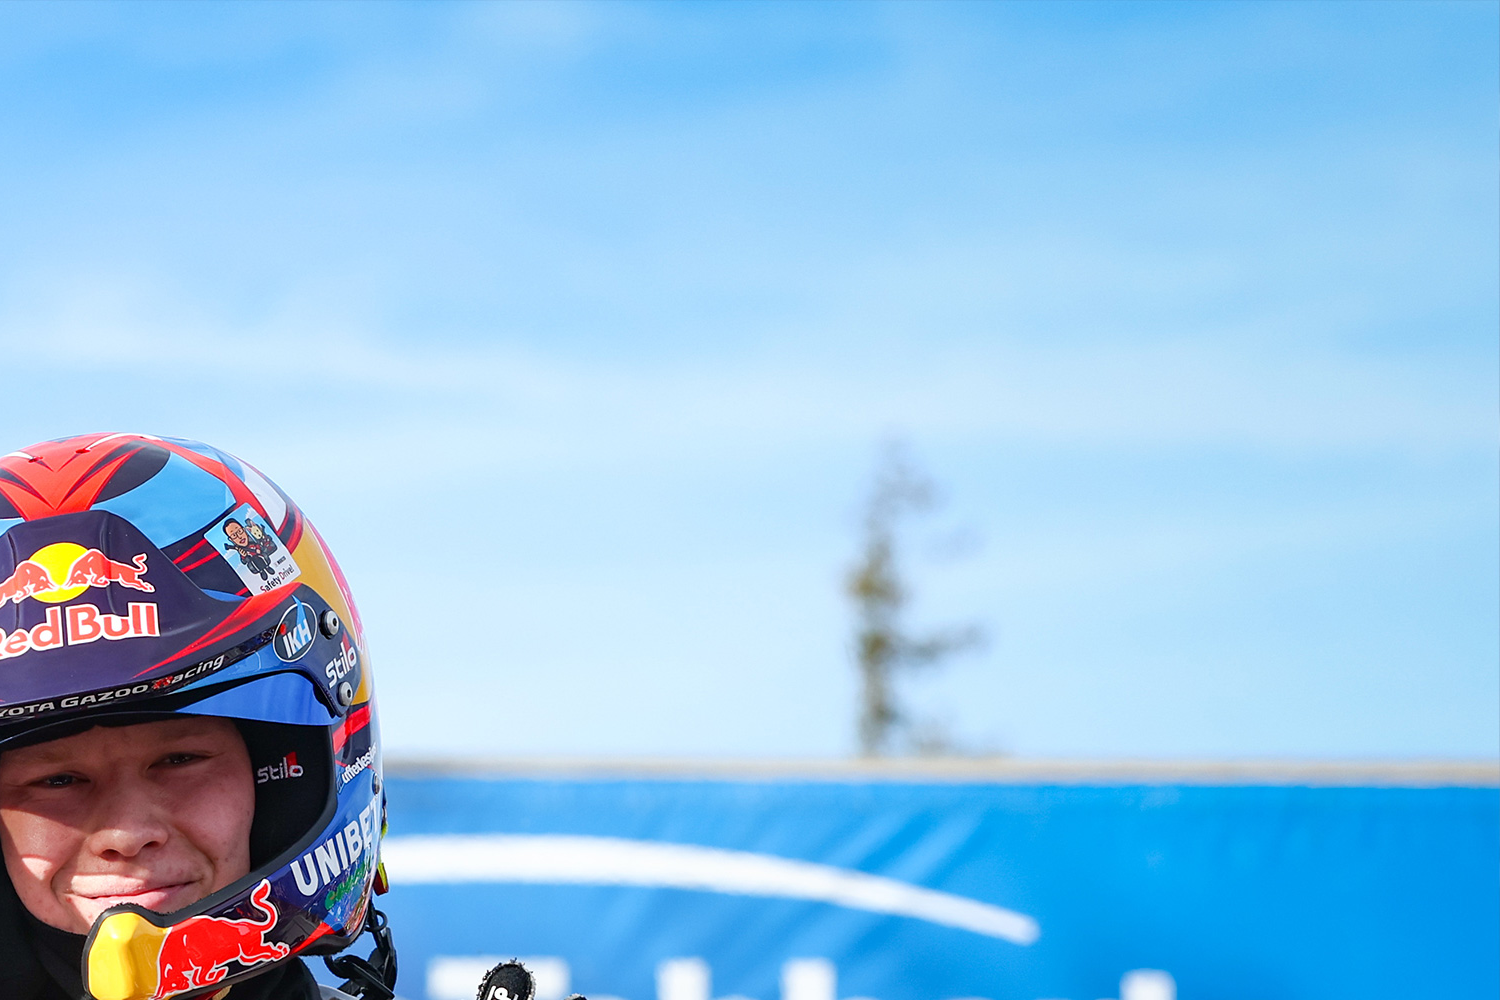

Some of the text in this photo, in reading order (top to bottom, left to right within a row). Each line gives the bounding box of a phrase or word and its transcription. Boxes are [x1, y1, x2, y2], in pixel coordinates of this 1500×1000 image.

[67, 603, 158, 644] Bull
[282, 619, 313, 659] IKH
[61, 684, 148, 709] GAZOO
[152, 654, 225, 690] Racing
